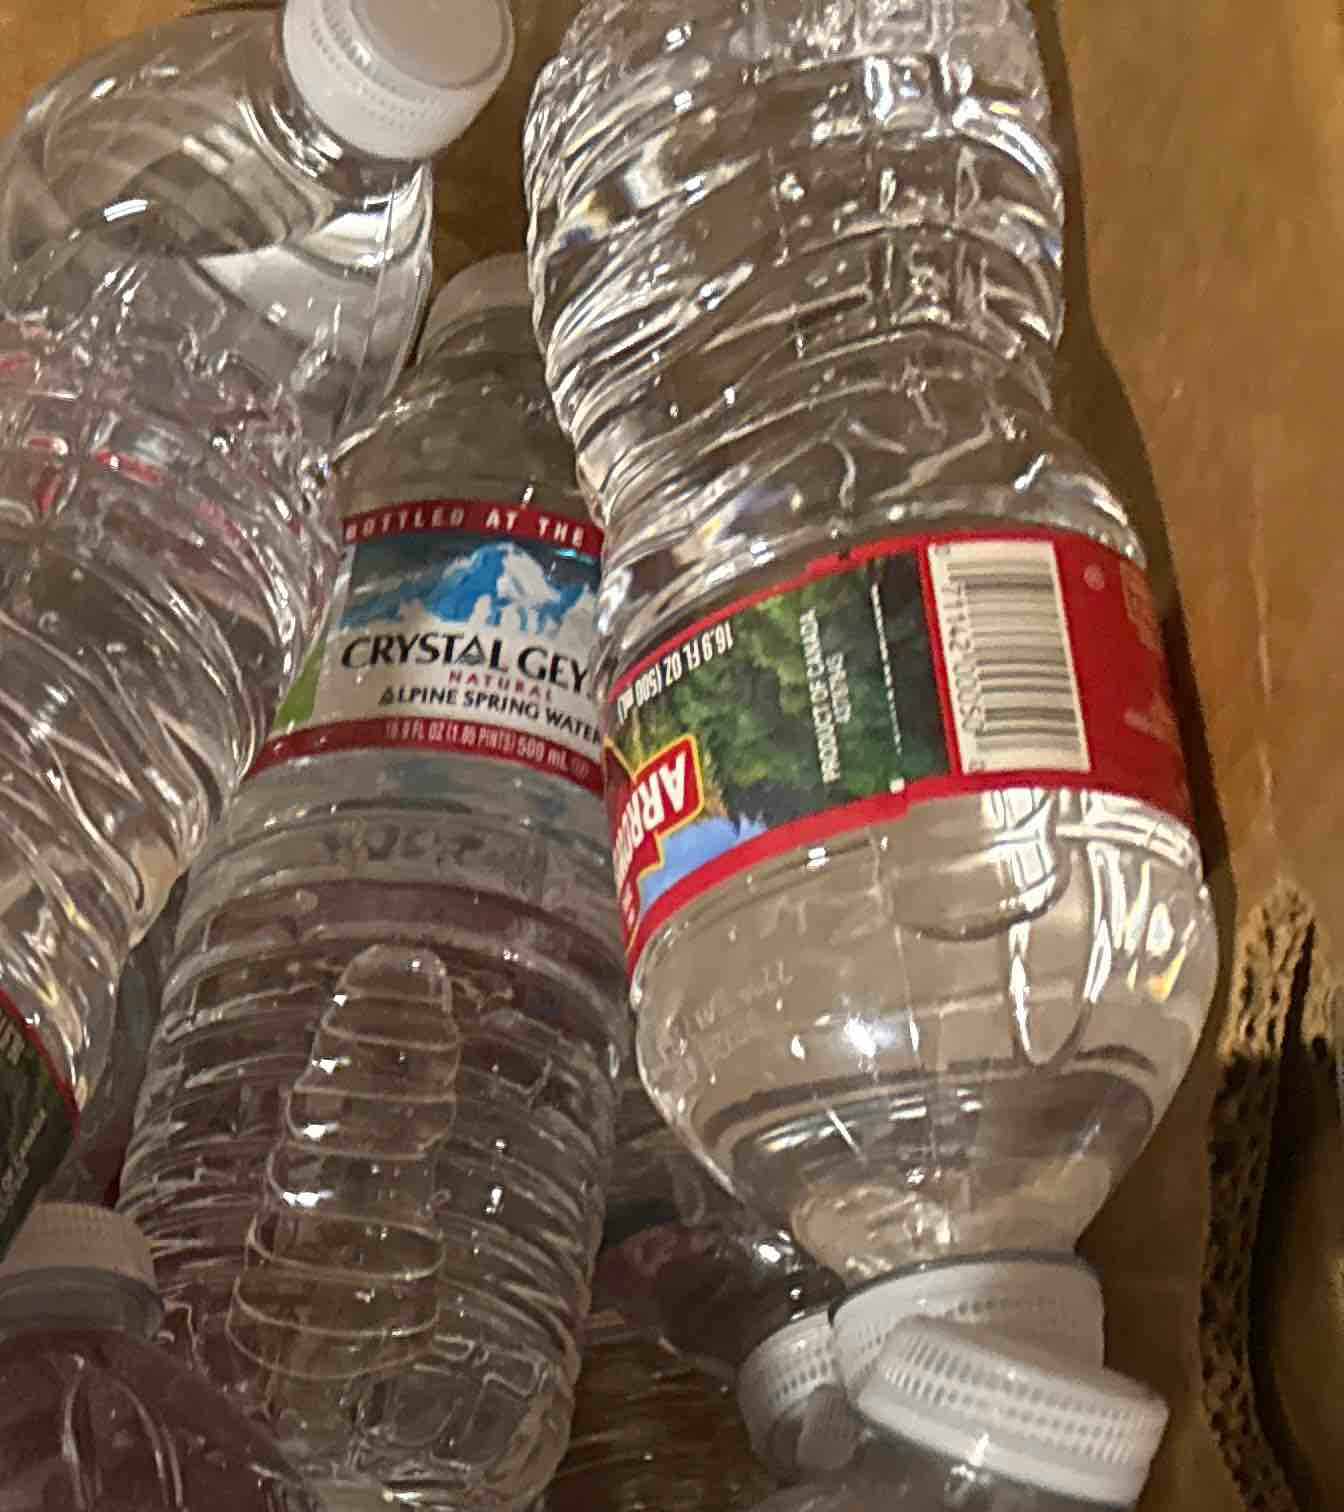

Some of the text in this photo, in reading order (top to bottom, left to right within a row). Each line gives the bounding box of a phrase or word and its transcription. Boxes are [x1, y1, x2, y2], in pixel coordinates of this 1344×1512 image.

[346, 508, 585, 548] BOTTLED AT THE
[682, 638, 701, 671] FL
[701, 619, 734, 662] 16.9
[341, 633, 591, 699] CRYSTAL GEY
[662, 651, 682, 687] OZ
[378, 685, 457, 706] ALPINE
[463, 689, 540, 721] SPRING
[447, 670, 552, 701] NATURAL
